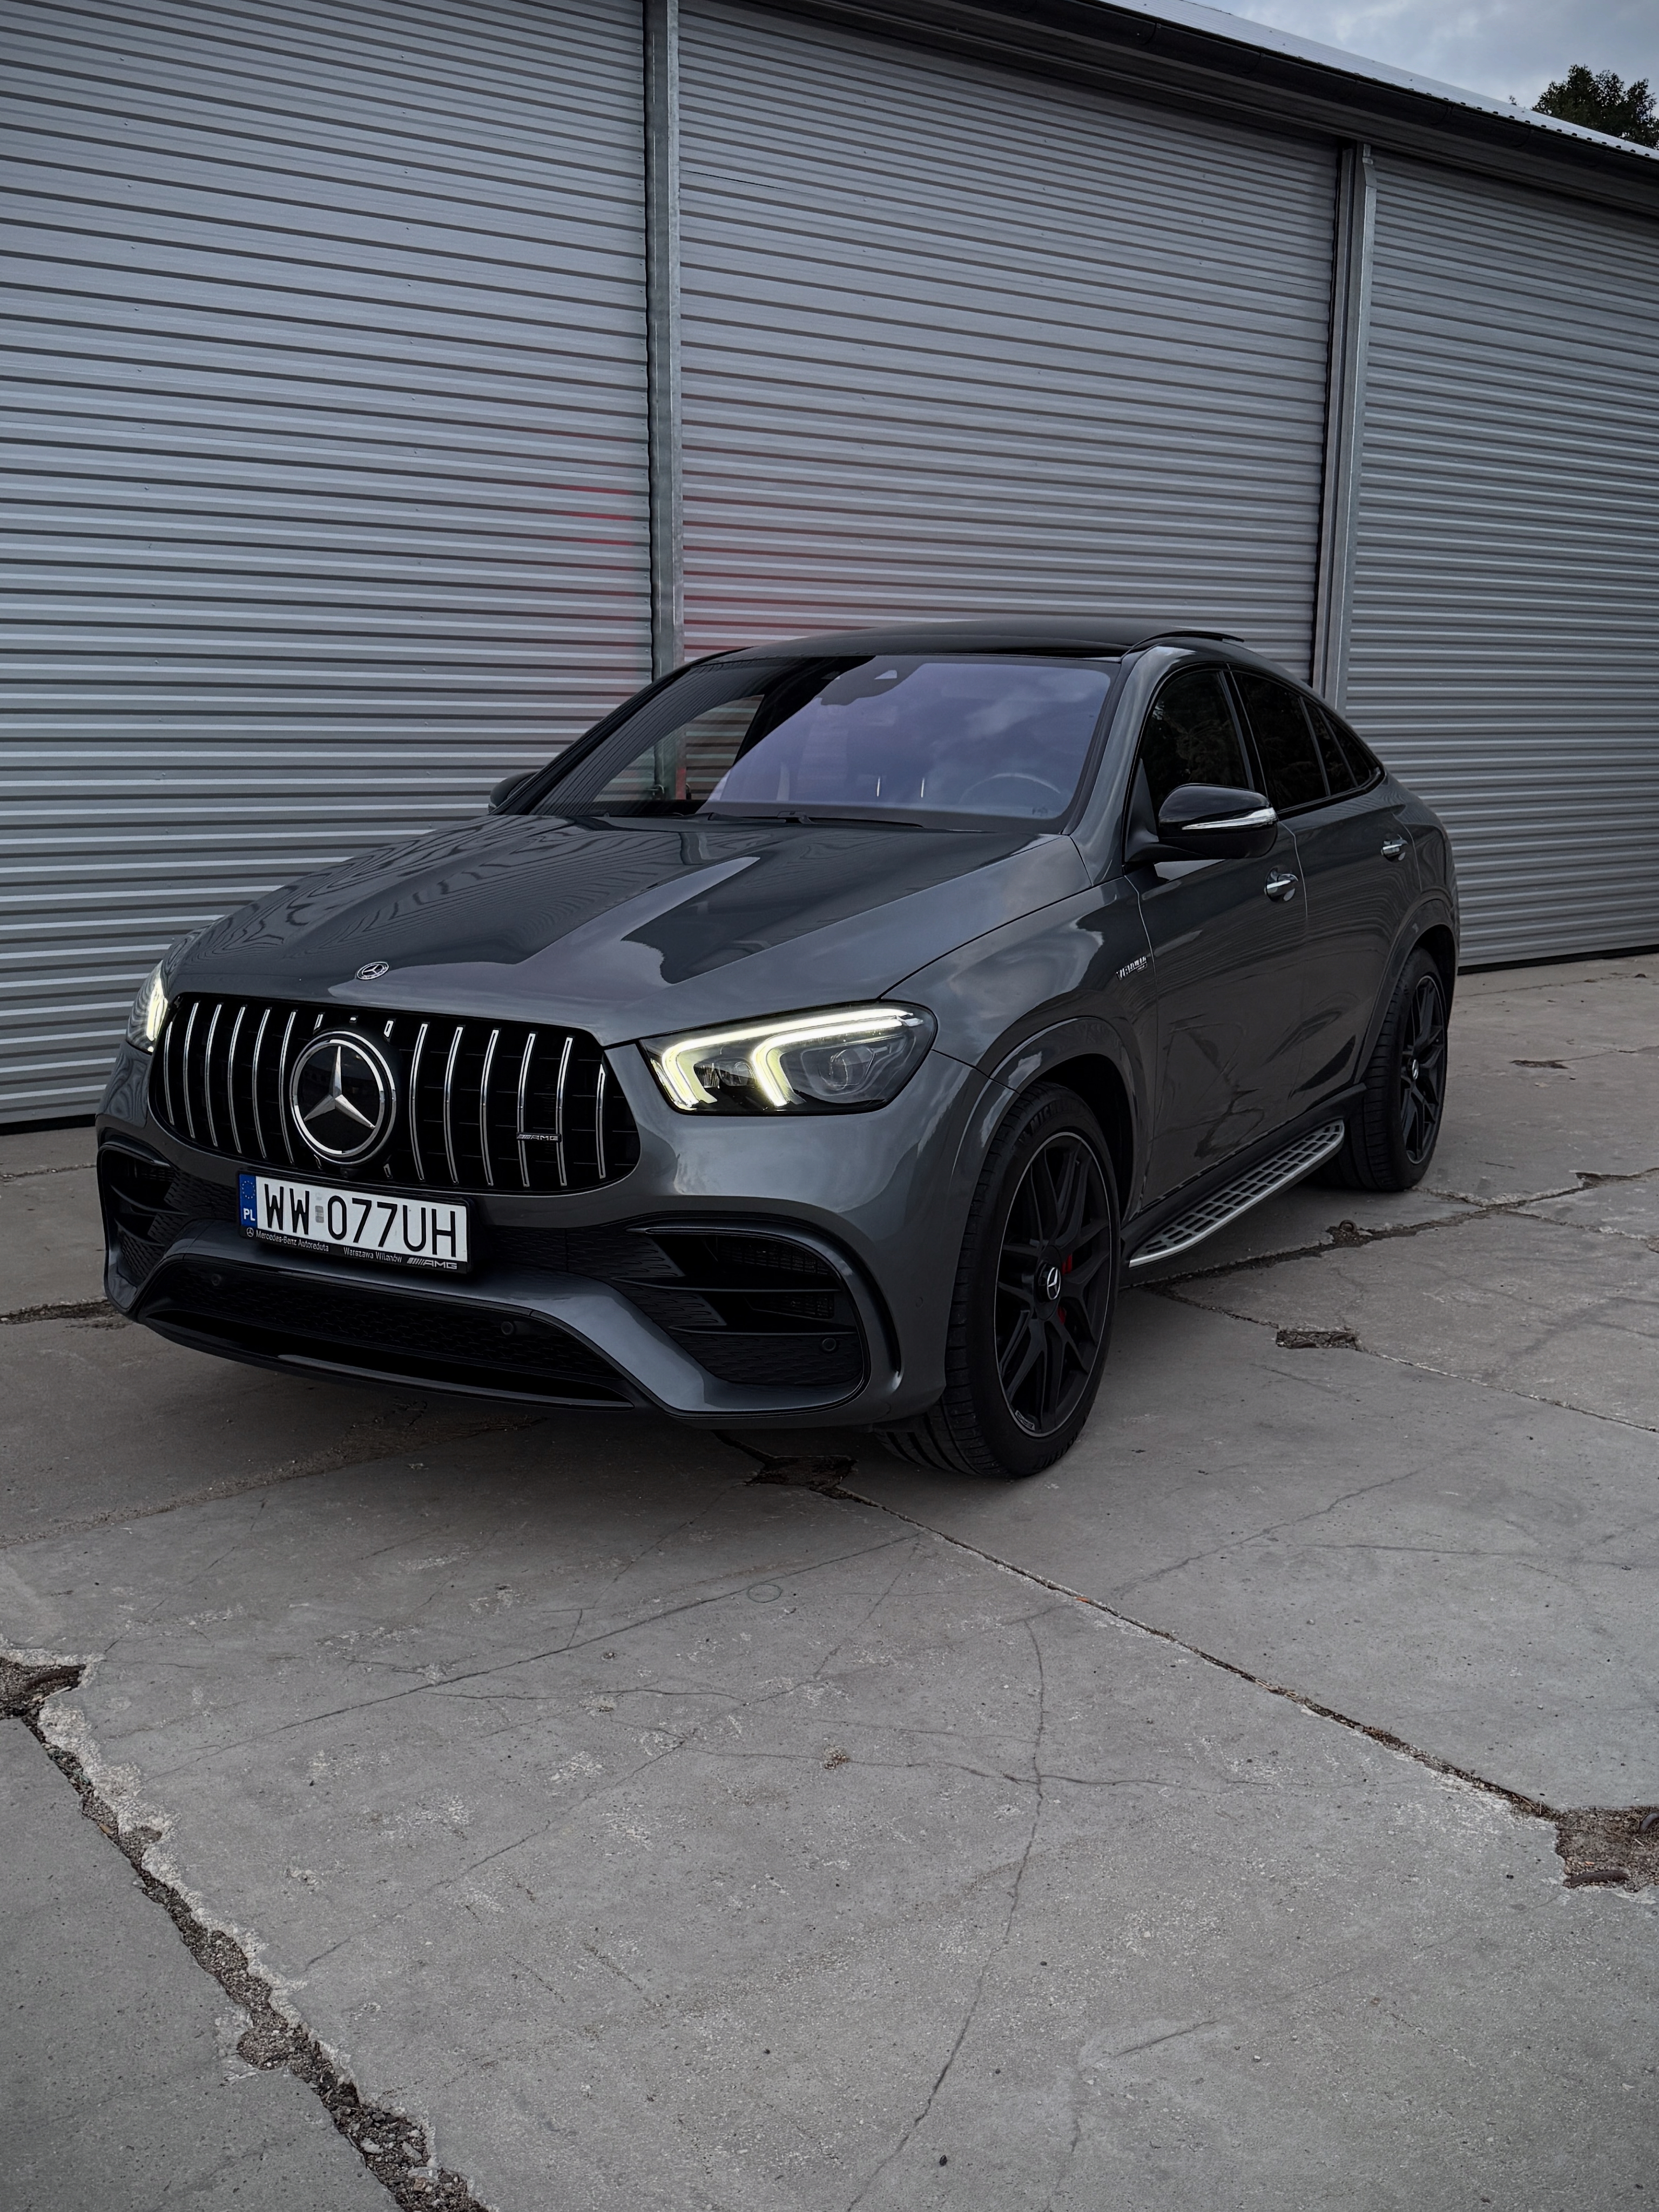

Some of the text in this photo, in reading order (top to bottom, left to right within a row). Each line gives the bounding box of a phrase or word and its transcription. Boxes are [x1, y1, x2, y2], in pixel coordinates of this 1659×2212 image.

[243, 1208, 255, 1222] PL
[265, 1184, 456, 1258] WW 077UH
[256, 1230, 328, 1252] Mercedes-Benz Autoreduta
[343, 1246, 374, 1259] Warszawa
